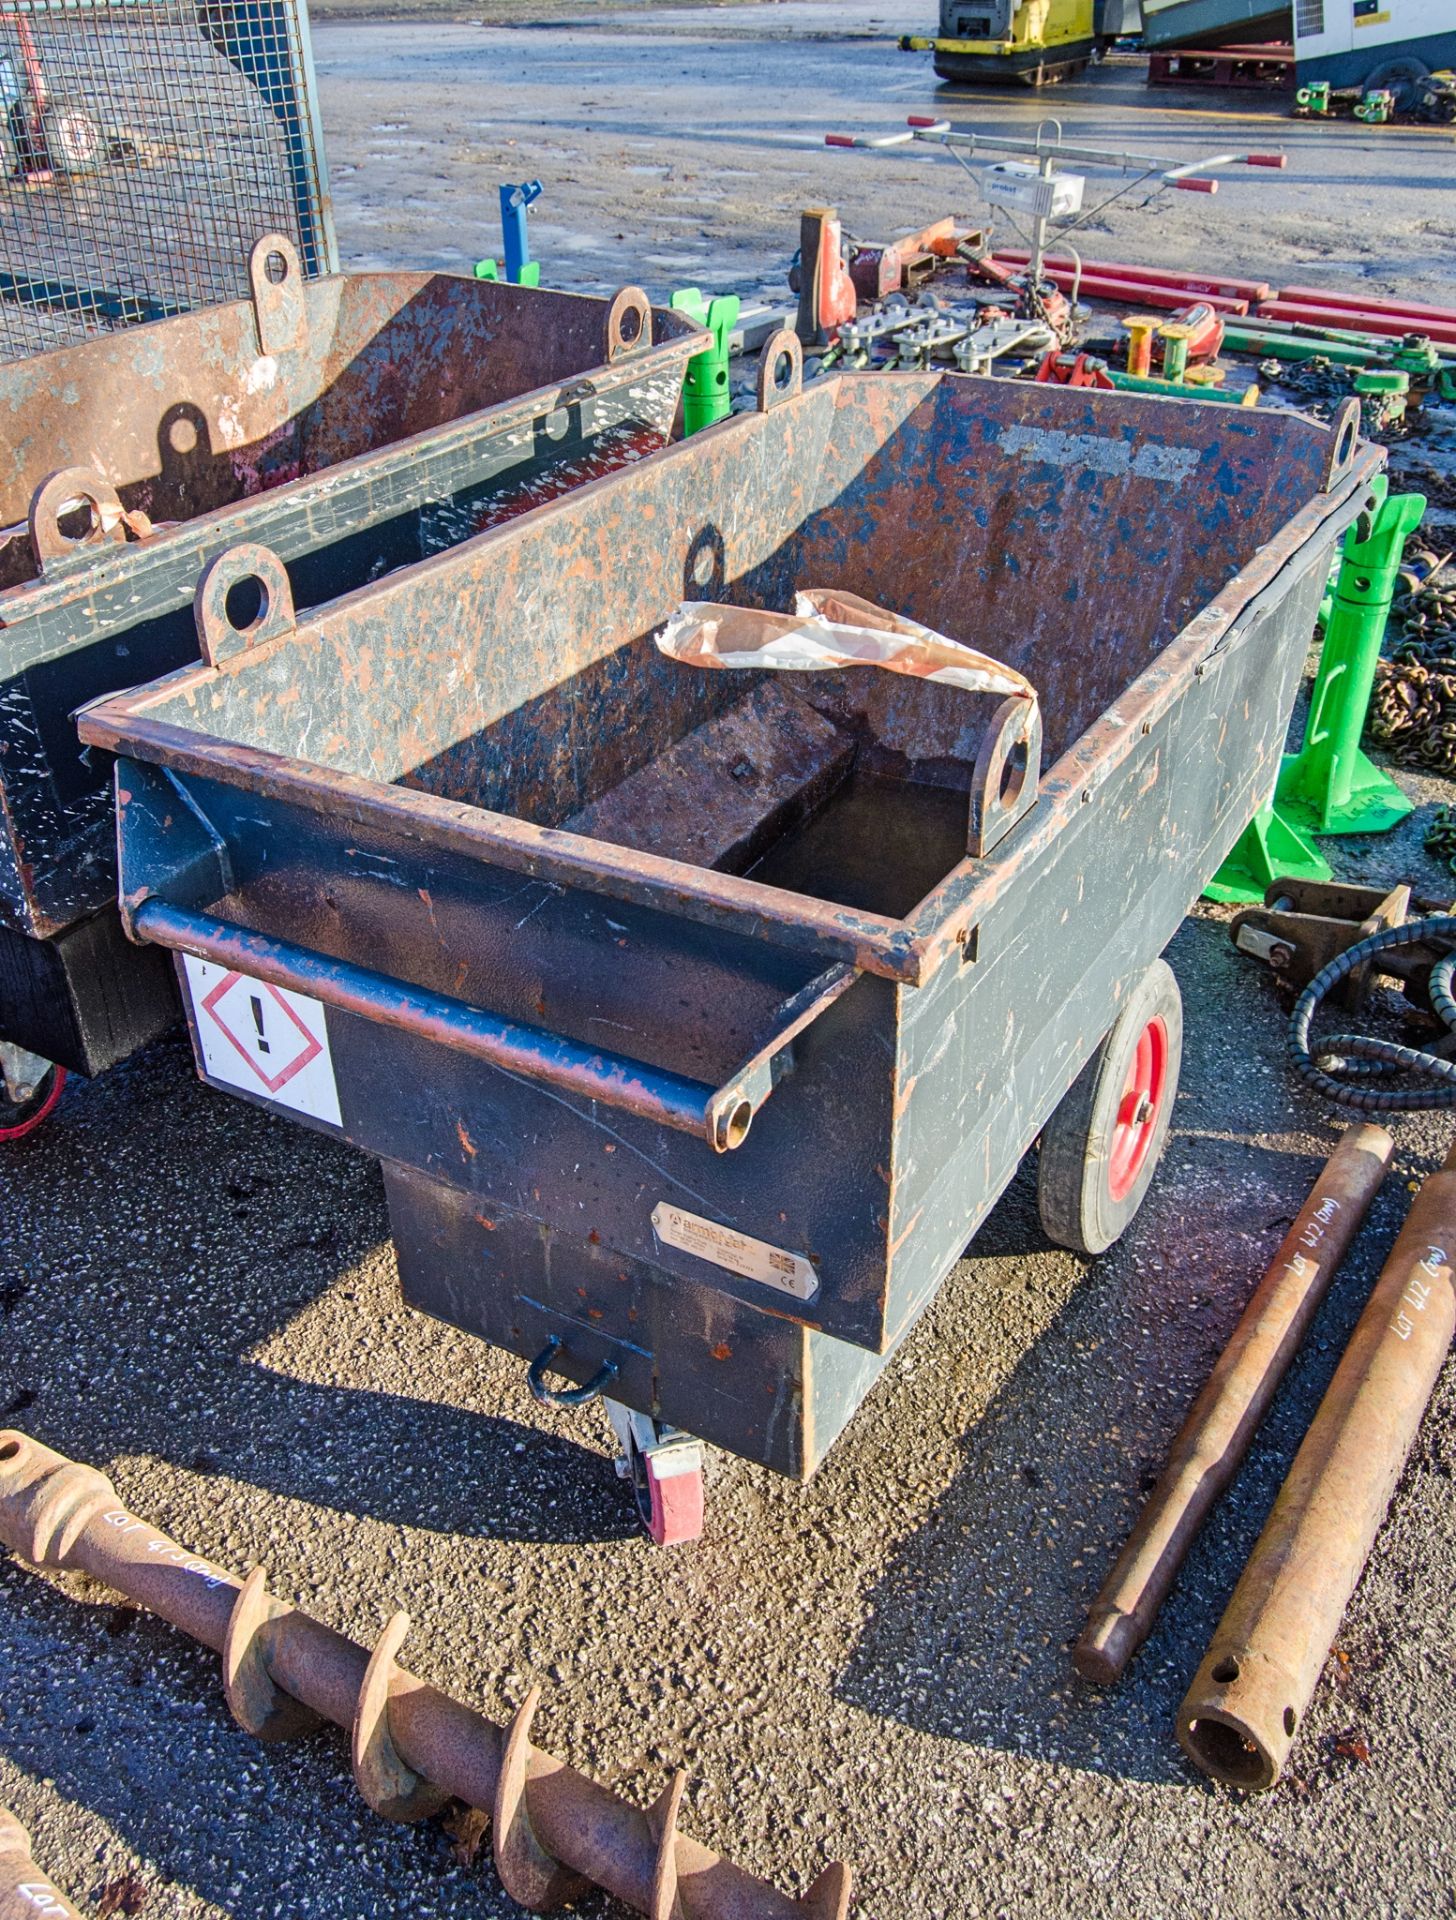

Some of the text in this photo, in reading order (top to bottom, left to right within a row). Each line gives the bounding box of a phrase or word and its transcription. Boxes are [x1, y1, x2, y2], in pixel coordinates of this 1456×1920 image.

[991, 181, 1017, 193] probst
[1284, 1251, 1308, 1277] LOT
[1300, 1222, 1325, 1248] 412
[1389, 1311, 1413, 1341] LOT
[1405, 1280, 1431, 1311] 412
[102, 1511, 147, 1533] LOT
[148, 1540, 190, 1562] 413
[17, 1883, 69, 1918] LOT
